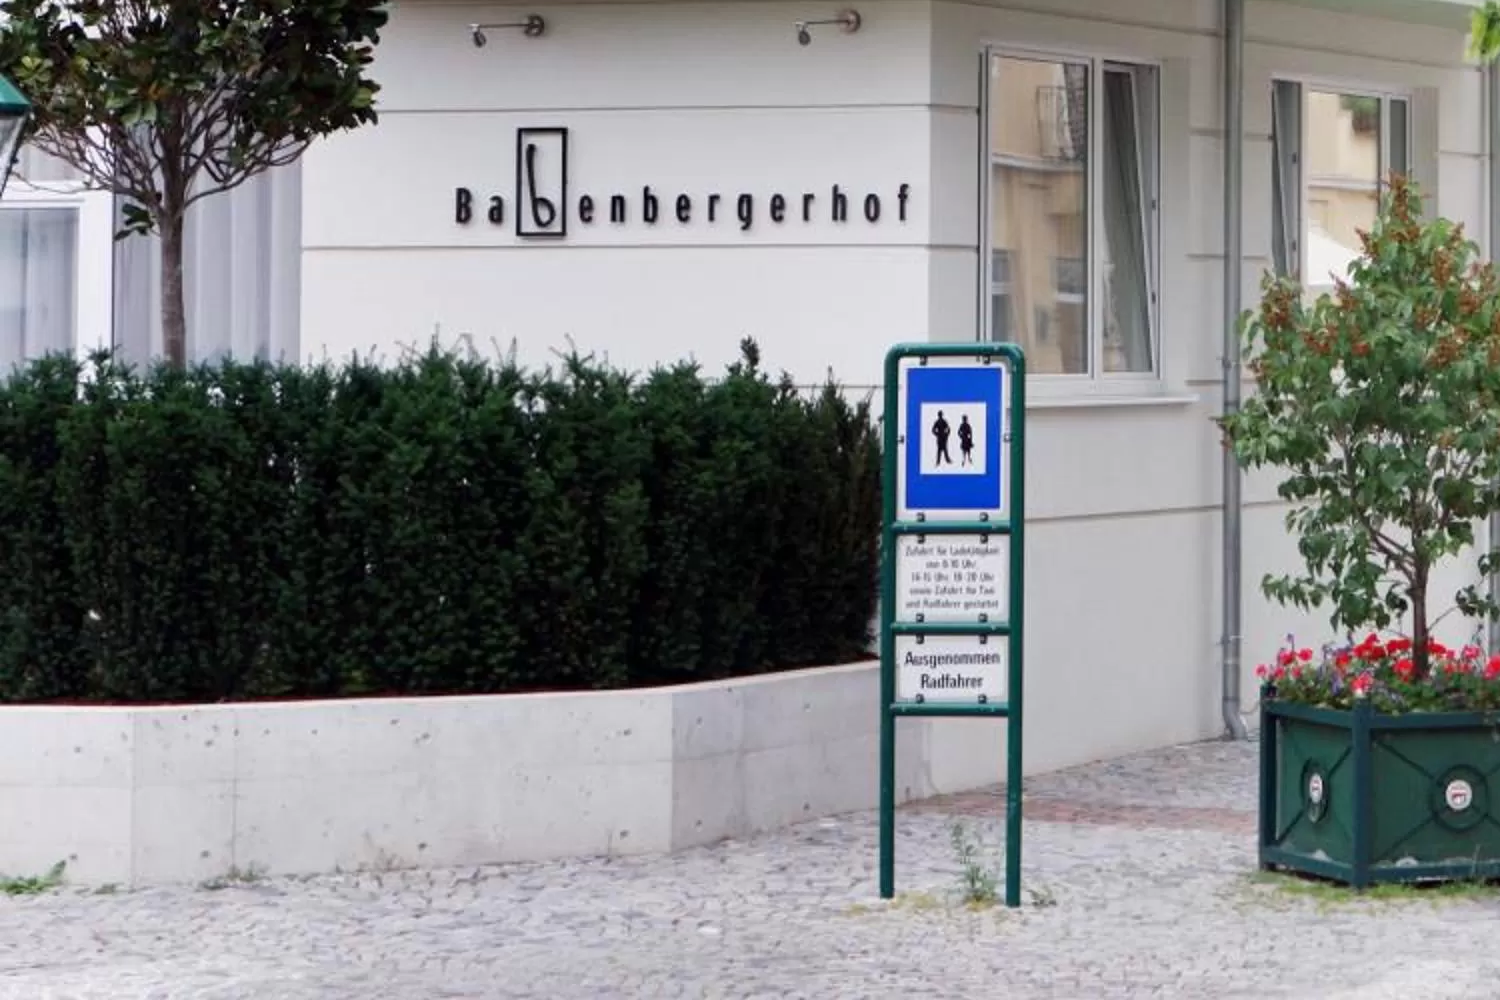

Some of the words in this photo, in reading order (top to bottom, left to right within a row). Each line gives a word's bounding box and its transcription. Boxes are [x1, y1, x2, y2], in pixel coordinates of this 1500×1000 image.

[455, 142, 909, 231] Babenbergerhof
[904, 651, 1001, 669] Ausgenommen
[920, 673, 984, 689] Radfahrer
